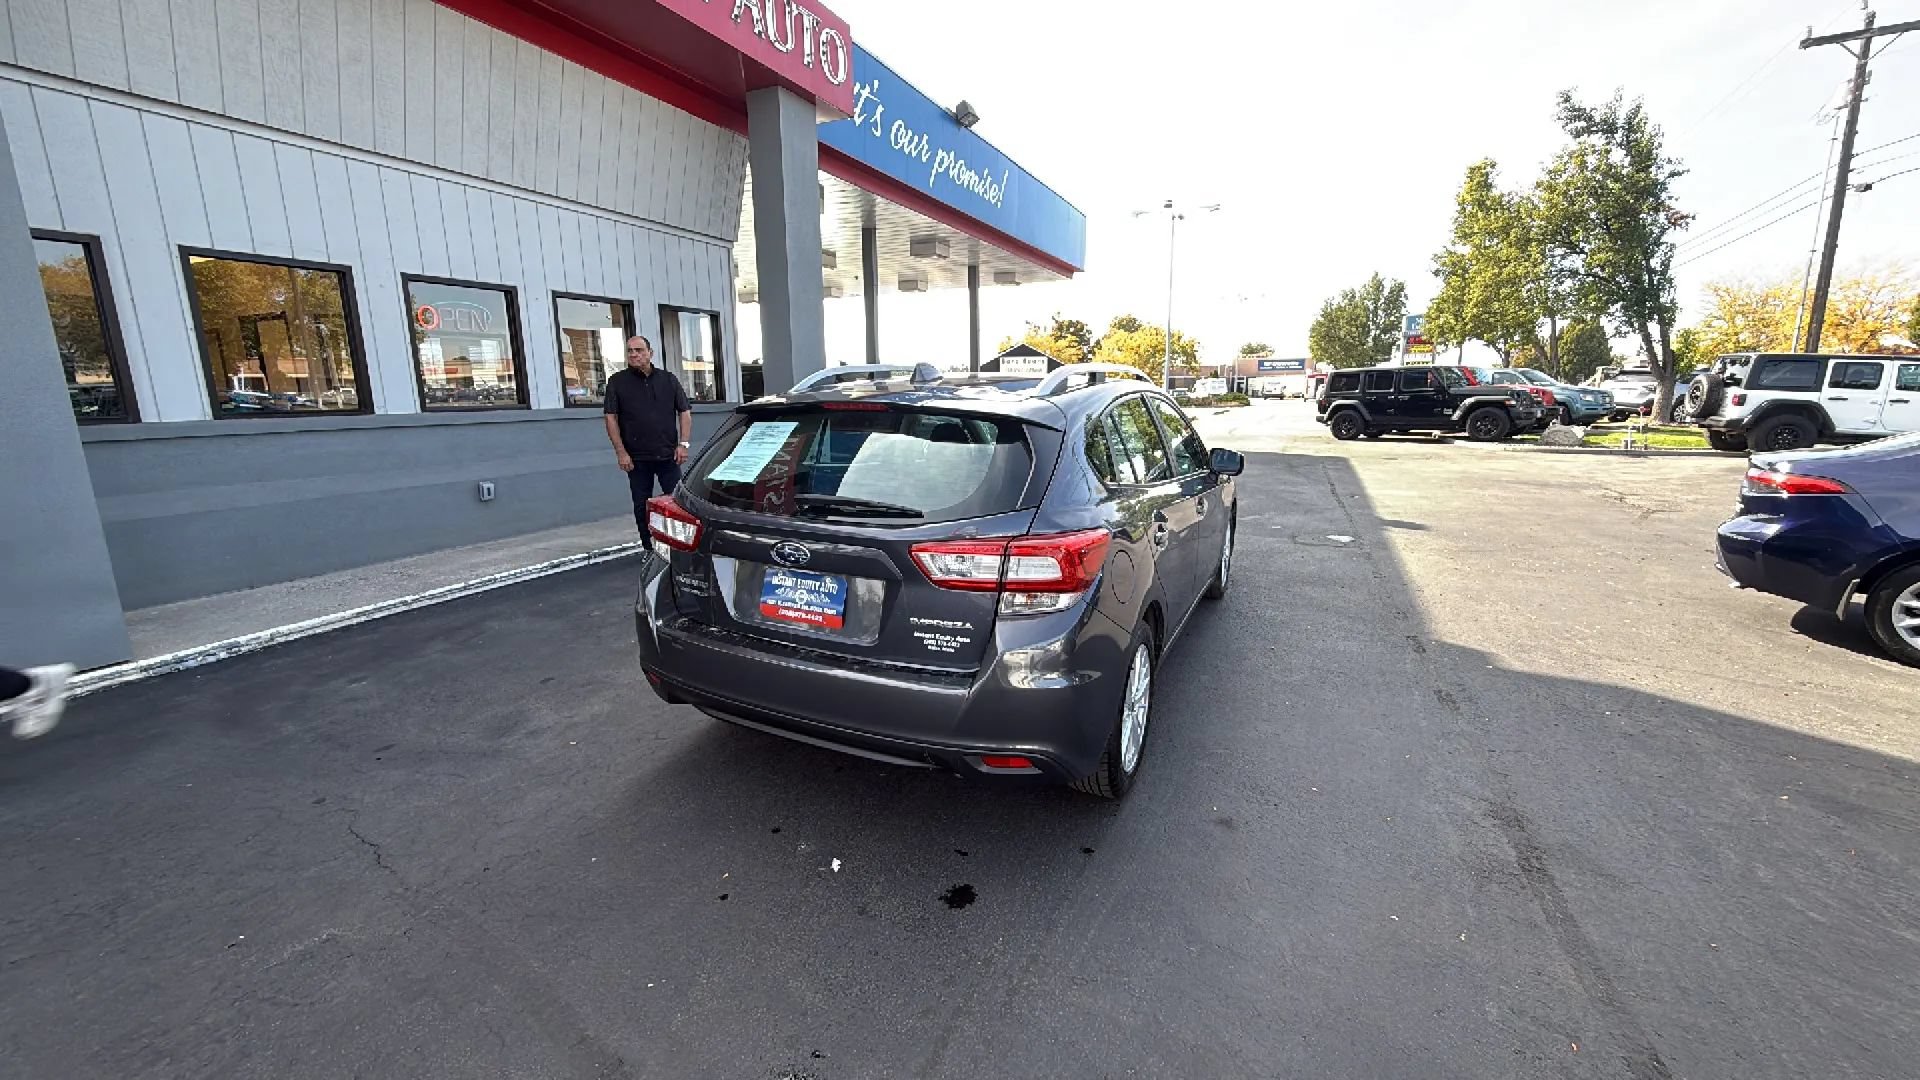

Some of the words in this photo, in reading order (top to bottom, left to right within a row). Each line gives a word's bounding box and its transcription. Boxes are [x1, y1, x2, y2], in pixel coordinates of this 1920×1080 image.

[890, 119, 932, 163] our
[929, 147, 1009, 209] promise!
[417, 304, 488, 332] OPEN
[771, 575, 797, 587] INSTANT
[819, 582, 838, 595] AUTO
